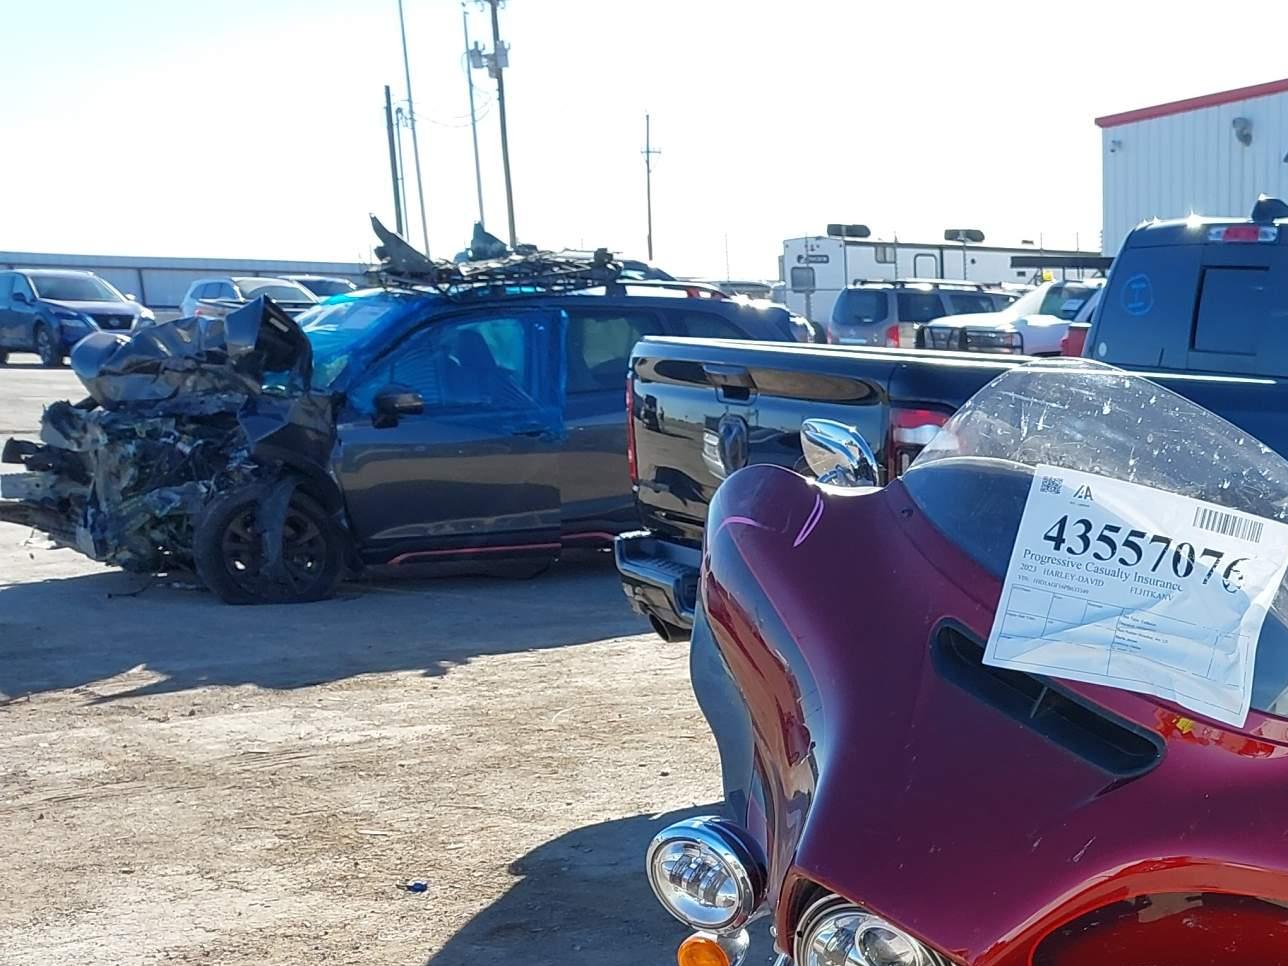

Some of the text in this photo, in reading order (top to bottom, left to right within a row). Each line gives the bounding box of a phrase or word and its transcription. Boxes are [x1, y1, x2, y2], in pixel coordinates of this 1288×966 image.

[1023, 548, 1083, 570] Progressive
[1085, 563, 1131, 582] Casualty
[1043, 514, 1251, 594] 43557076
[1043, 567, 1105, 587] HARLEY-DAVID
